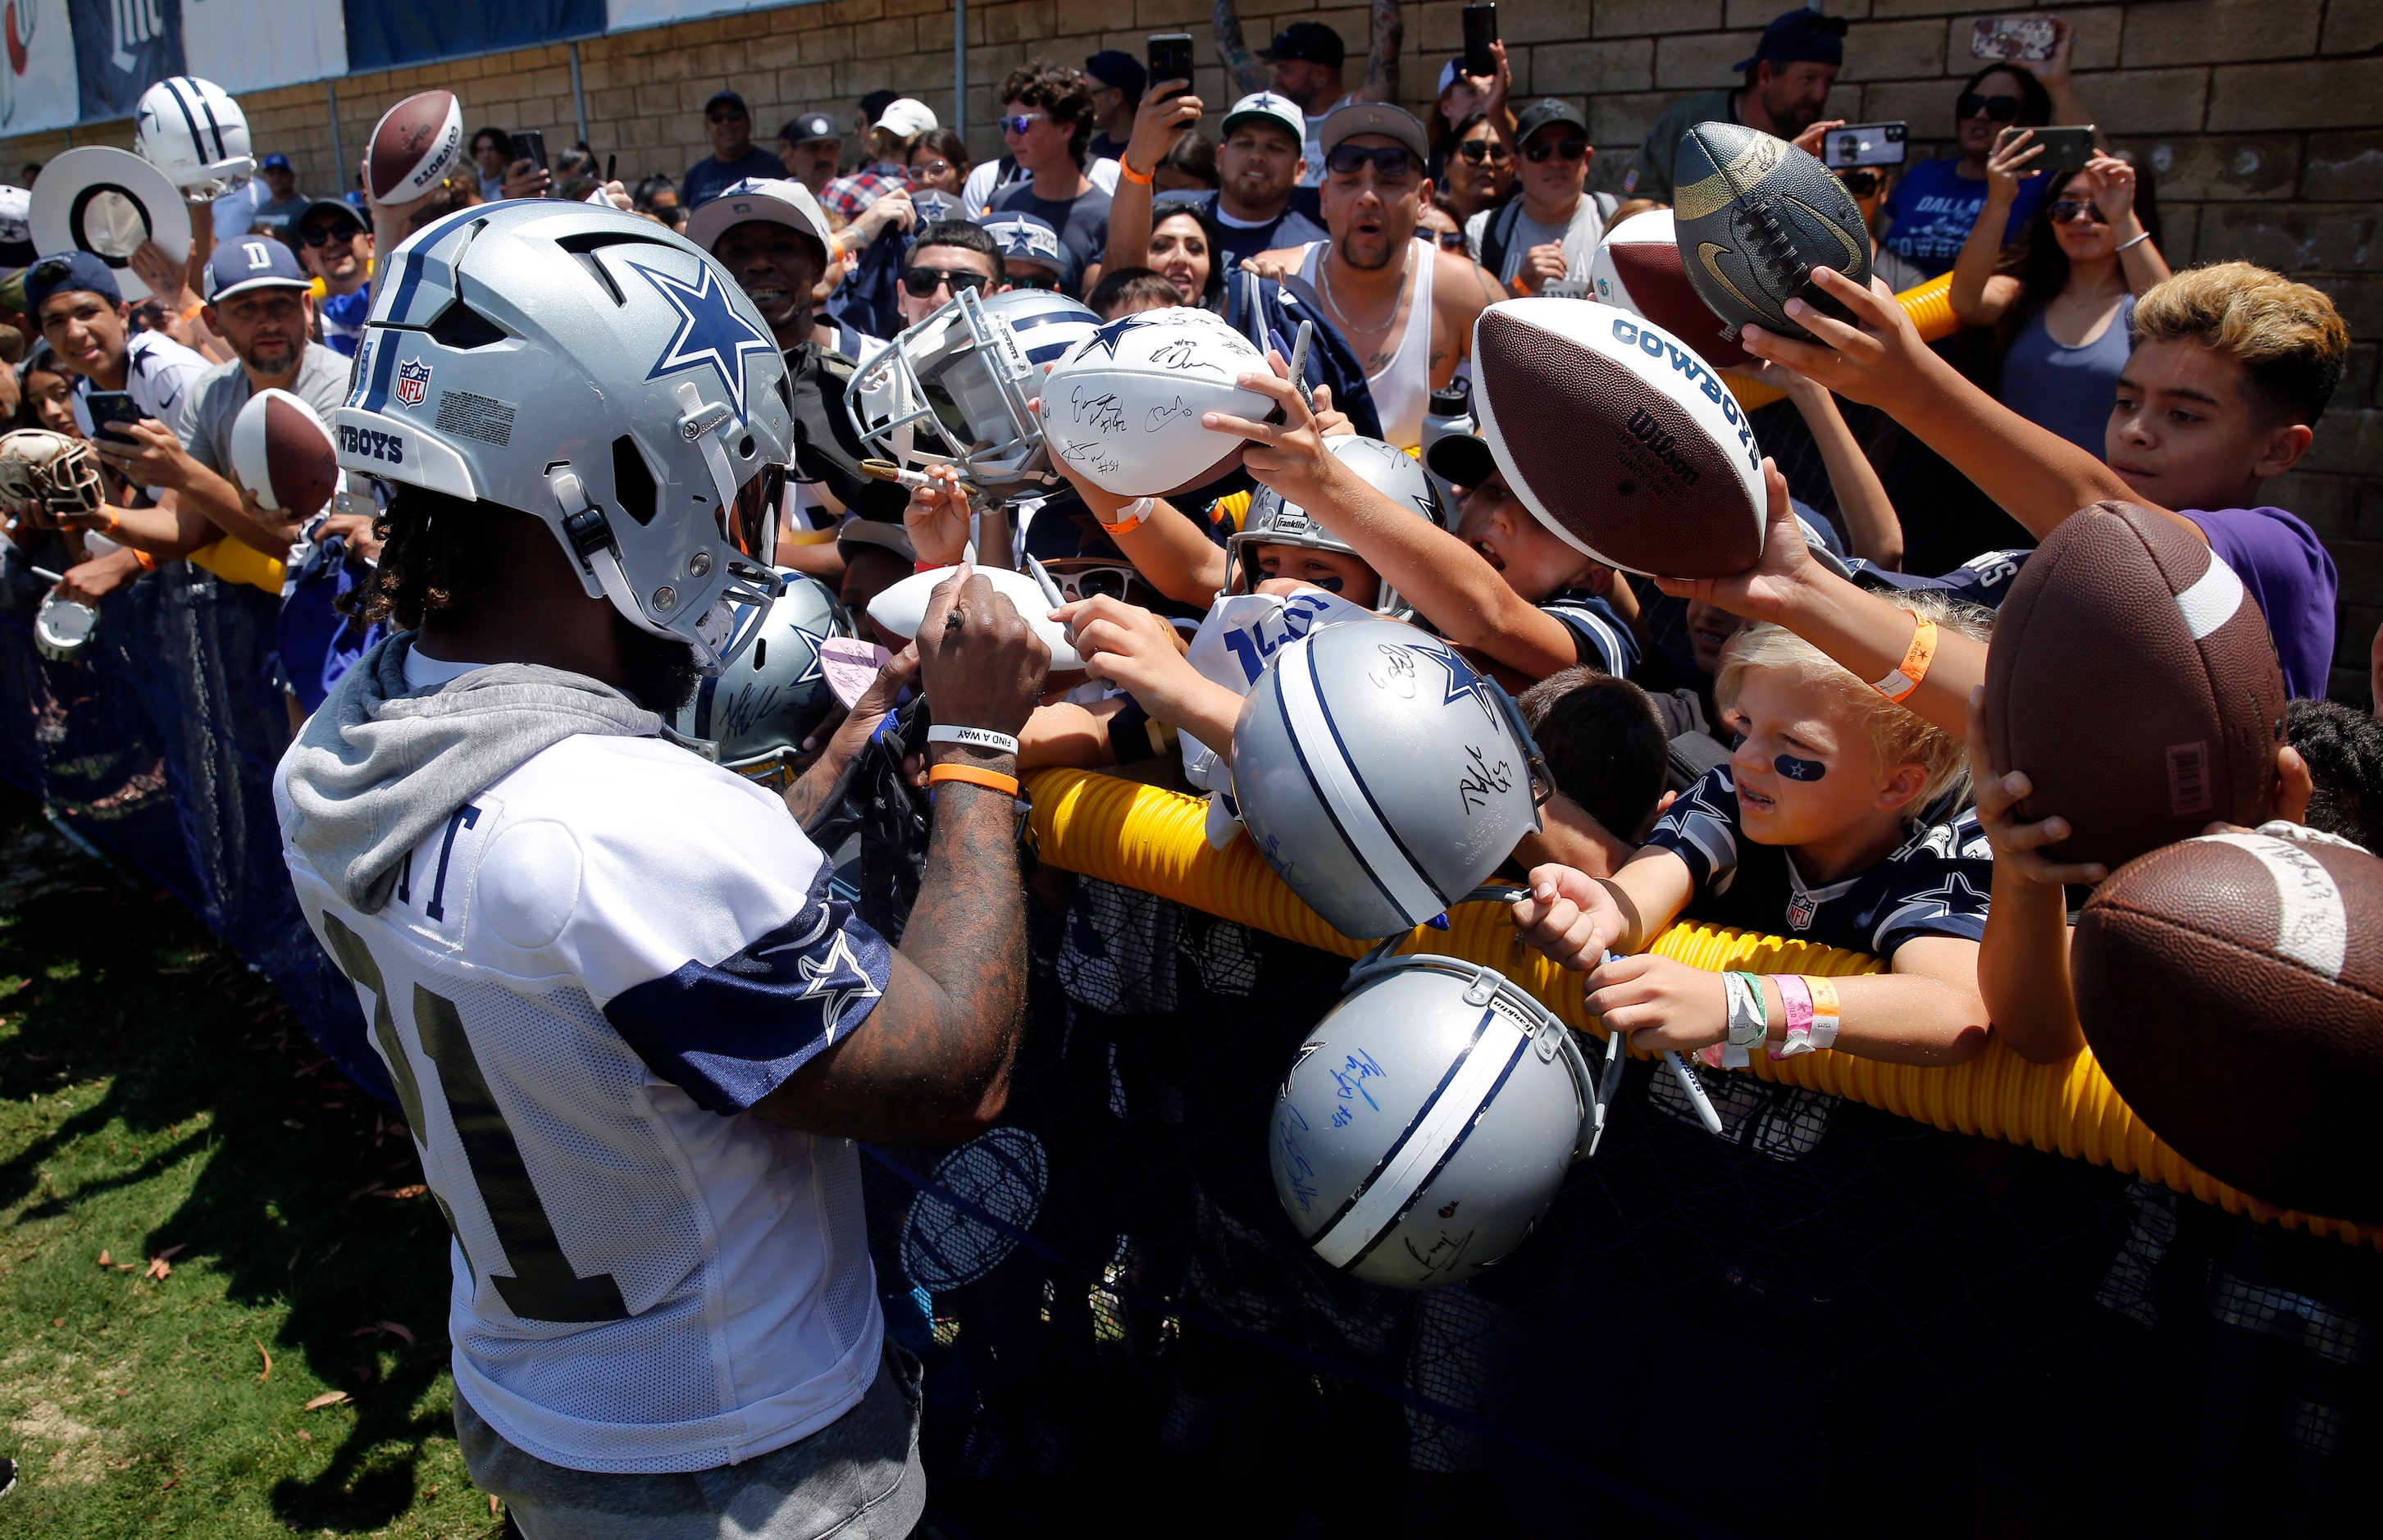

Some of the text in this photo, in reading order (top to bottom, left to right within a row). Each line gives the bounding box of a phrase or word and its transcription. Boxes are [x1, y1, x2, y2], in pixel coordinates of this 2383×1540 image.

[413, 125, 459, 188] COWBOYS
[1915, 195, 1987, 213] DALLA
[242, 241, 273, 271] D
[1000, 328, 1019, 359] COWBOYS
[399, 378, 422, 401] NFL
[461, 390, 499, 404] WARNING
[1612, 318, 1763, 472] COWBOYS
[1626, 406, 1701, 488] Wilson
[1908, 640, 1921, 663] CREW
[957, 730, 1011, 747] FIND A WAY
[1789, 905, 1807, 926] NFL
[1786, 996, 1798, 1018] UNITED
[1674, 1050, 1704, 1096] OWBOYS
